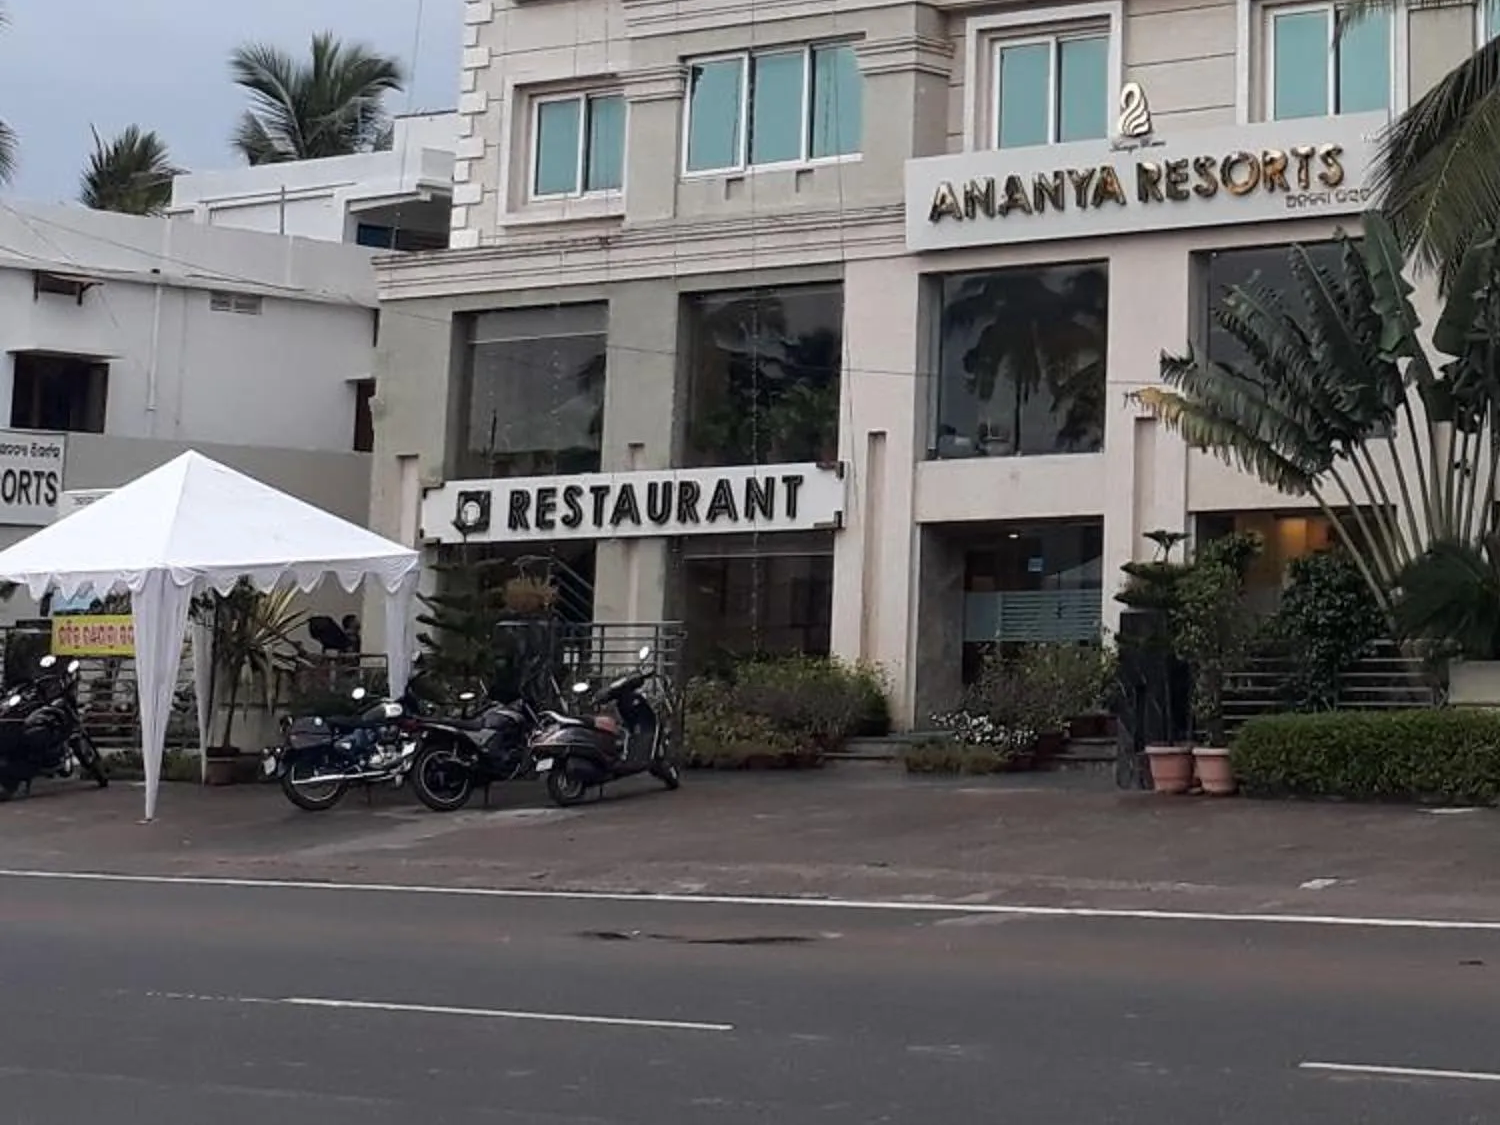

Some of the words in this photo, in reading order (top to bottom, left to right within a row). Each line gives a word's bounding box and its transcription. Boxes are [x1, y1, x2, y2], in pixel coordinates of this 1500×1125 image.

[928, 160, 1127, 223] ANANYA
[1136, 142, 1345, 204] RESORTS
[2, 469, 58, 506] ORTS
[507, 474, 804, 532] RESTAURANT
